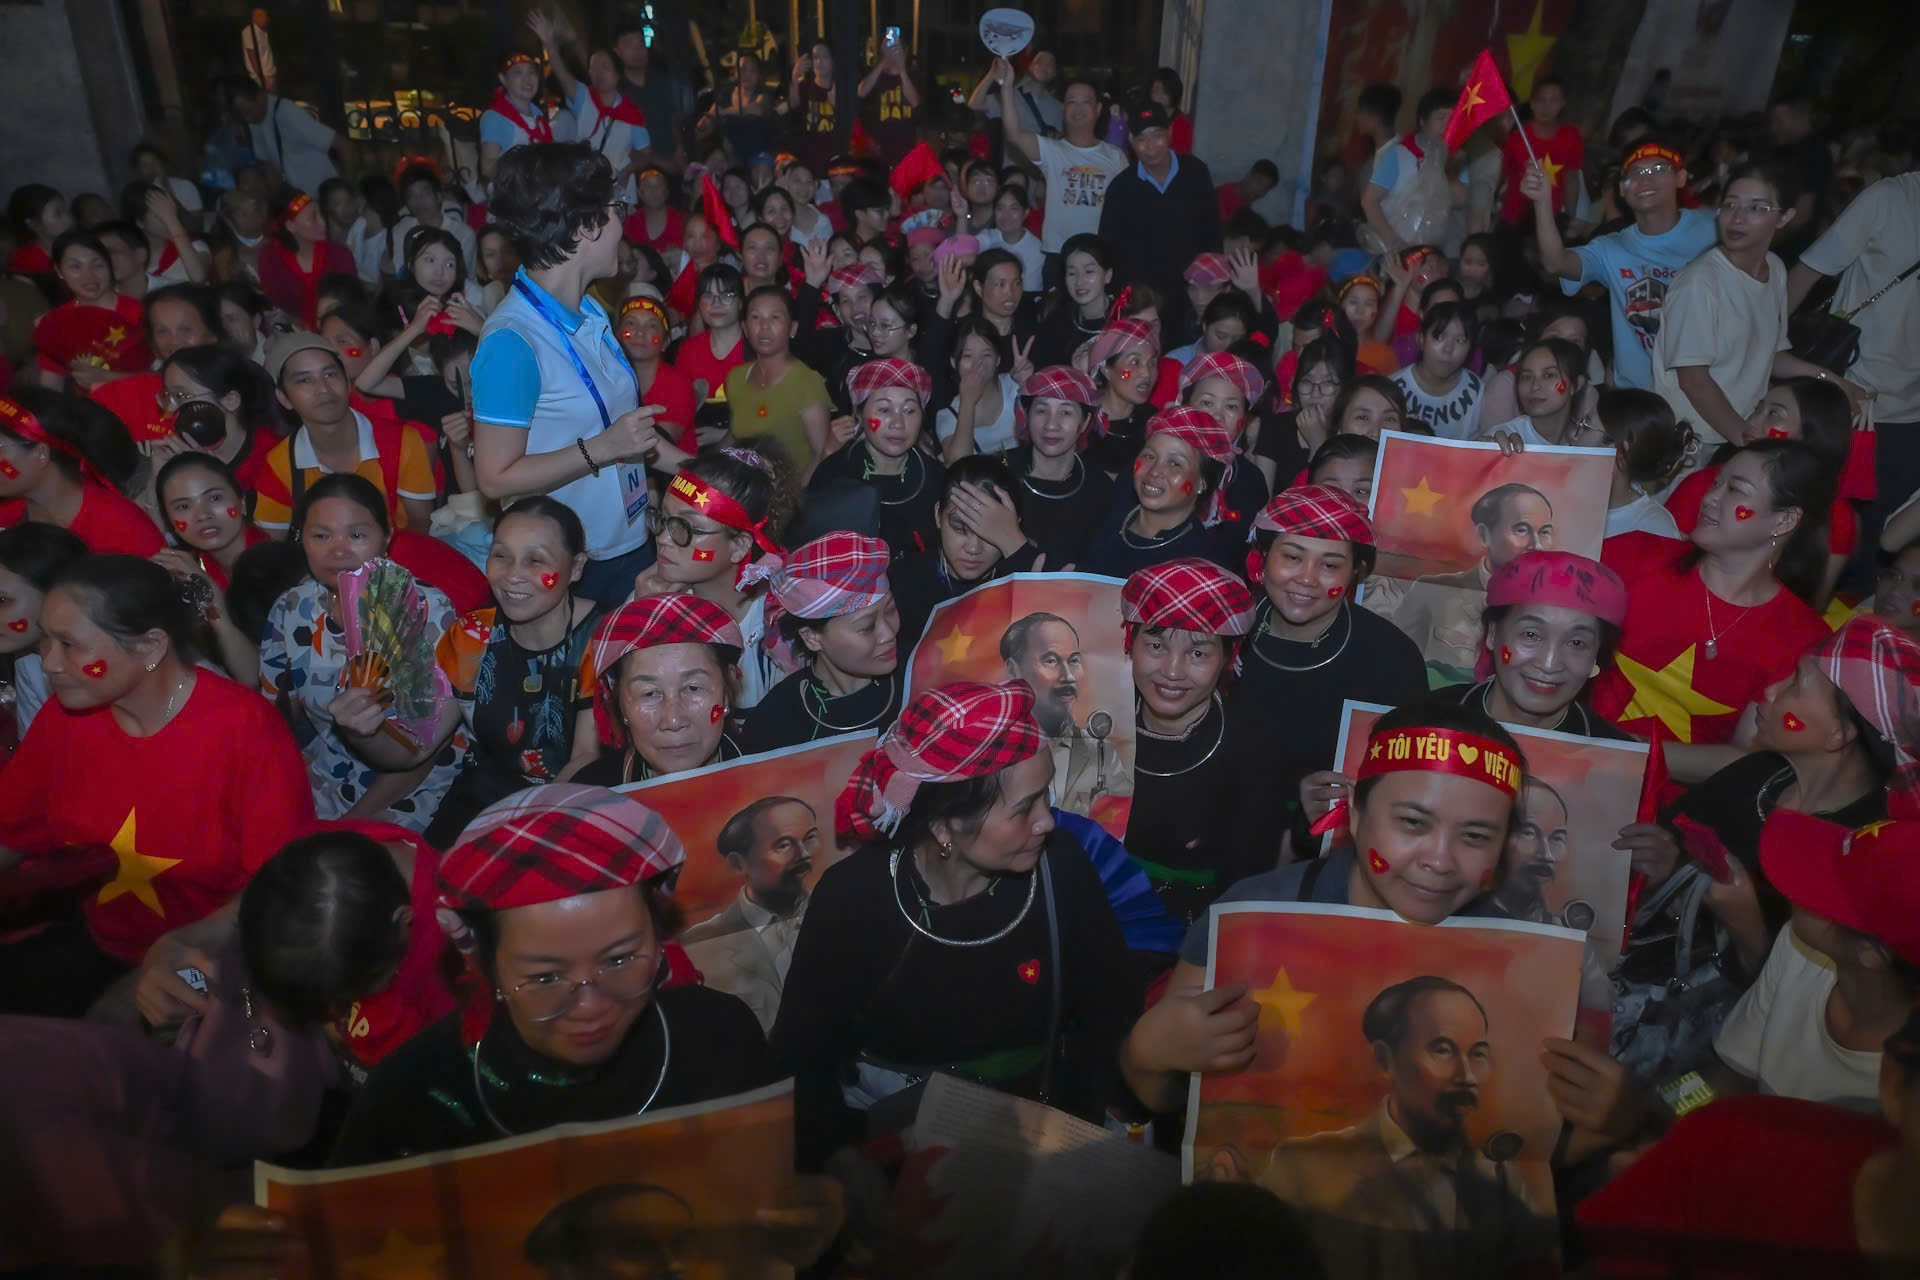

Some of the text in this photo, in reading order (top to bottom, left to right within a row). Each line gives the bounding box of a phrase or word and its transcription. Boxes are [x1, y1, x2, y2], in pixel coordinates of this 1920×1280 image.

[672, 475, 697, 497] NAM
[1387, 733, 1411, 760] TÔI
[1416, 732, 1450, 762] YÊU
[1484, 750, 1510, 784] VIỆT
